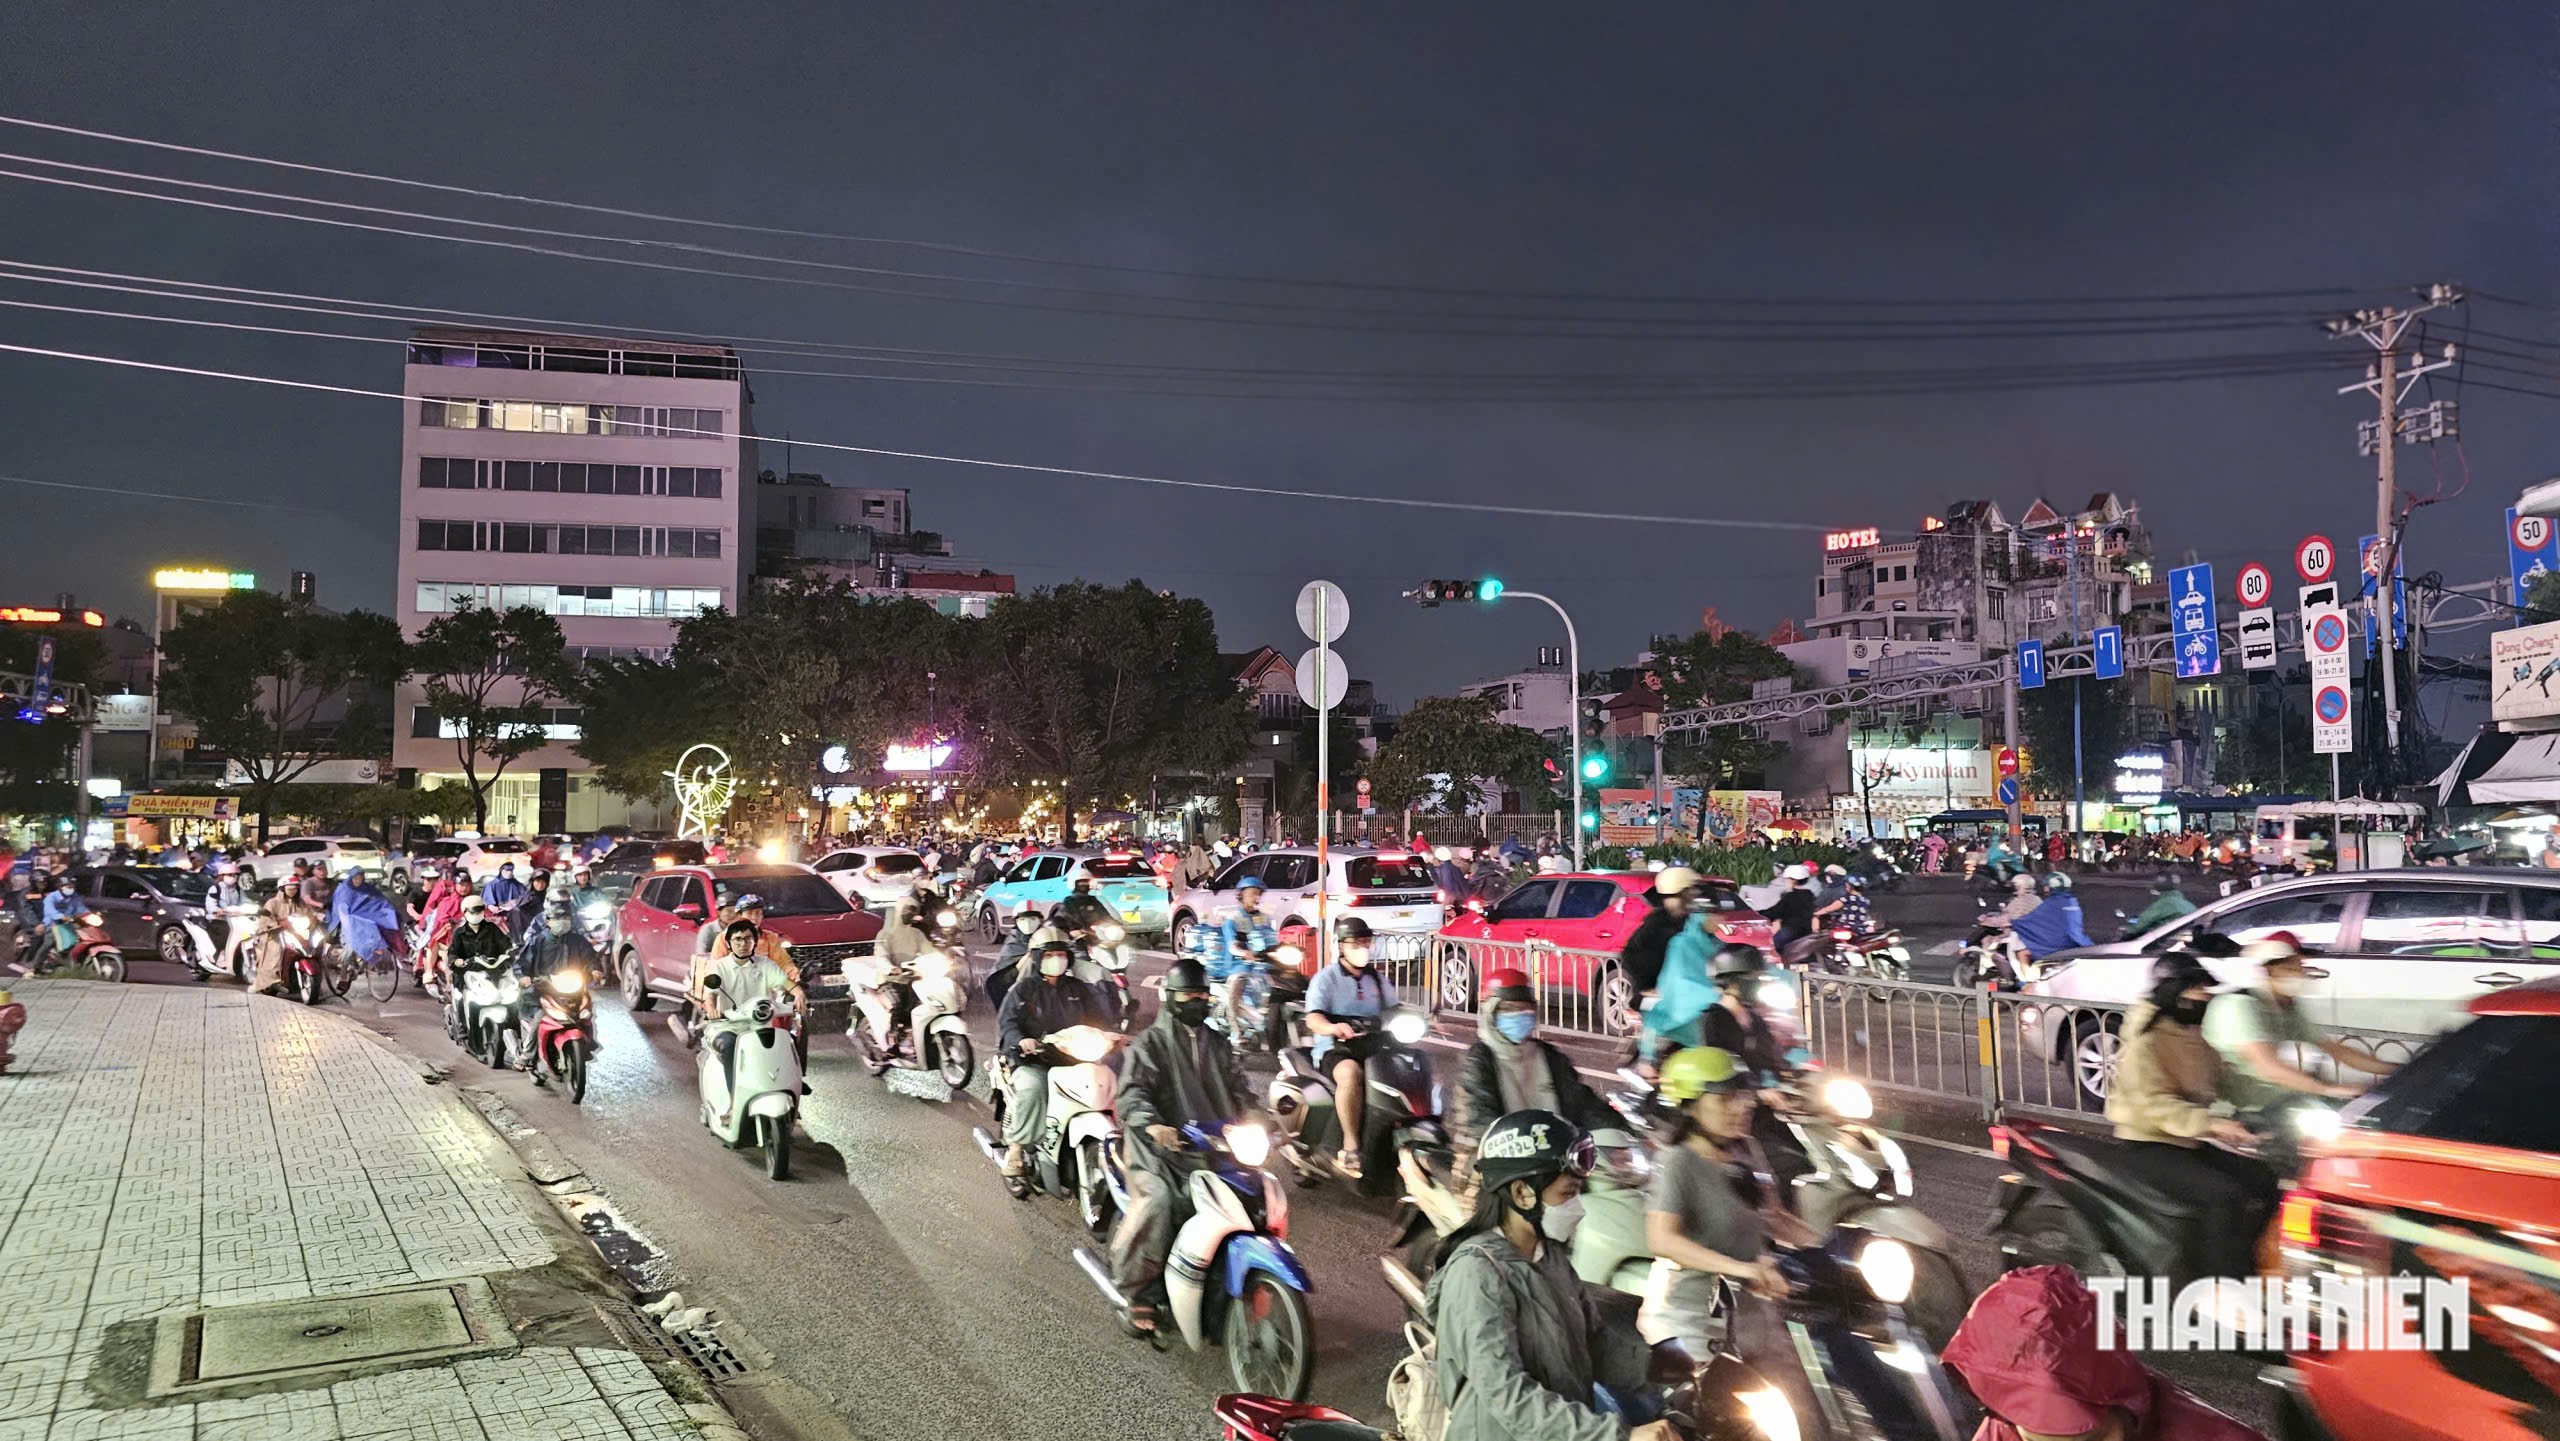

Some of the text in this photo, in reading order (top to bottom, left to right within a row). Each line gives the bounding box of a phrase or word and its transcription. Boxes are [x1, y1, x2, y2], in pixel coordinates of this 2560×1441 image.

[1827, 529, 1880, 550] HOTEL
[2522, 520, 2541, 540] 50
[2308, 549, 2324, 570] 60
[2246, 575, 2262, 595] 80
[1900, 763, 1978, 781] Kymdan
[1487, 1133, 1514, 1151] DEAD
